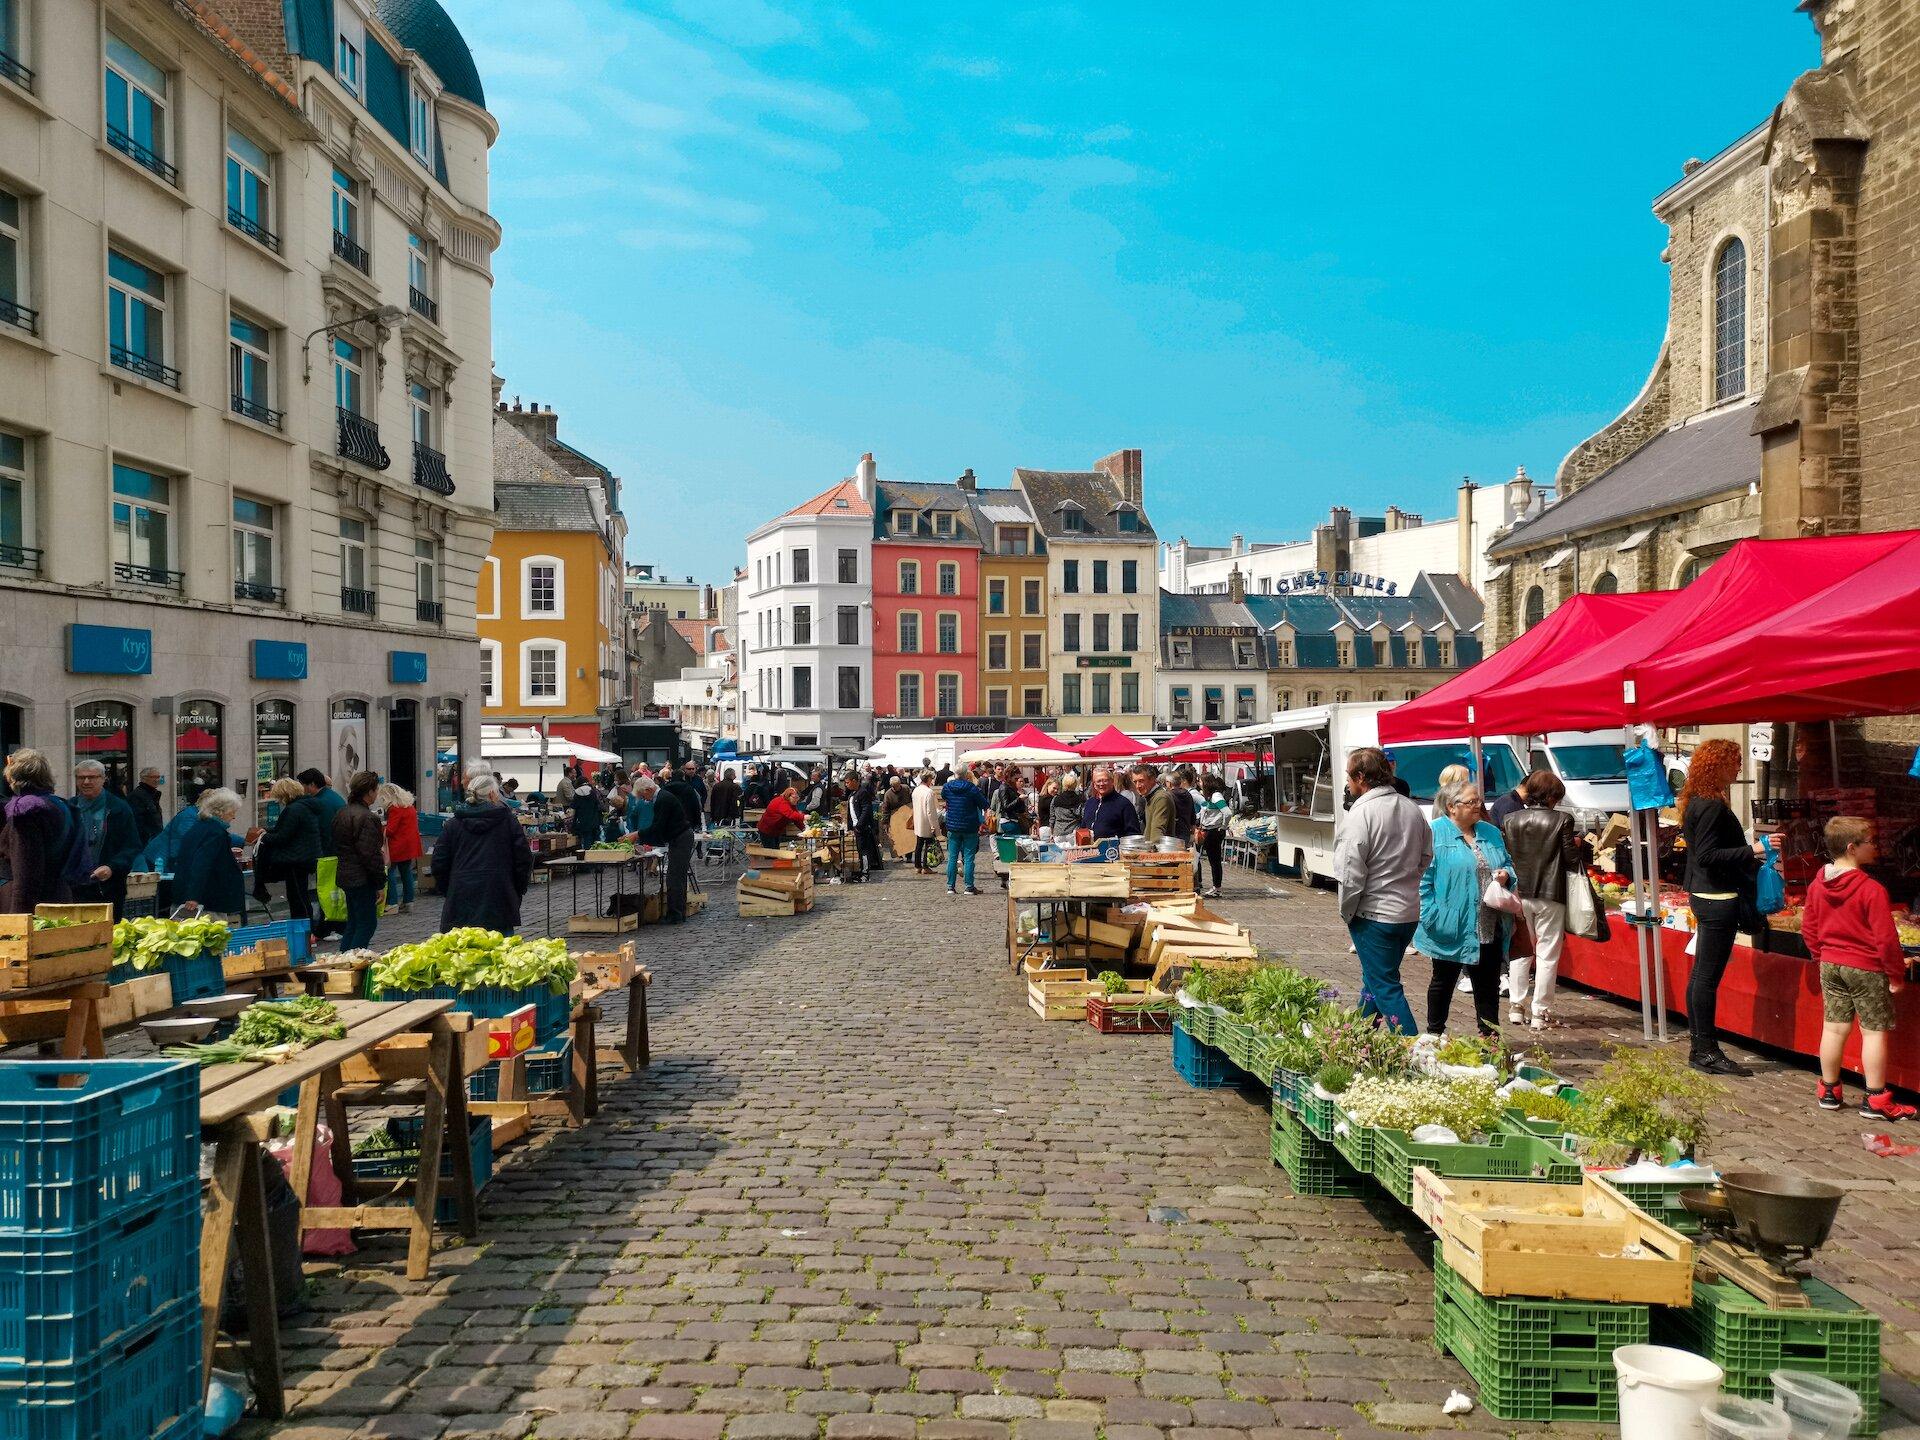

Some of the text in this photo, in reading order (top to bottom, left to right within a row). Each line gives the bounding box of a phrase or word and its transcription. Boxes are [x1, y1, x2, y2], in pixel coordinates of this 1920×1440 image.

[1277, 570, 1398, 596] CHEZ JULES
[1185, 626, 1245, 637] AU BUREAU
[122, 637, 146, 659] Krys
[288, 650, 304, 667] Krys
[74, 718, 129, 729] OPTICIEN Krys
[175, 714, 218, 725] OPTICIEN Krys
